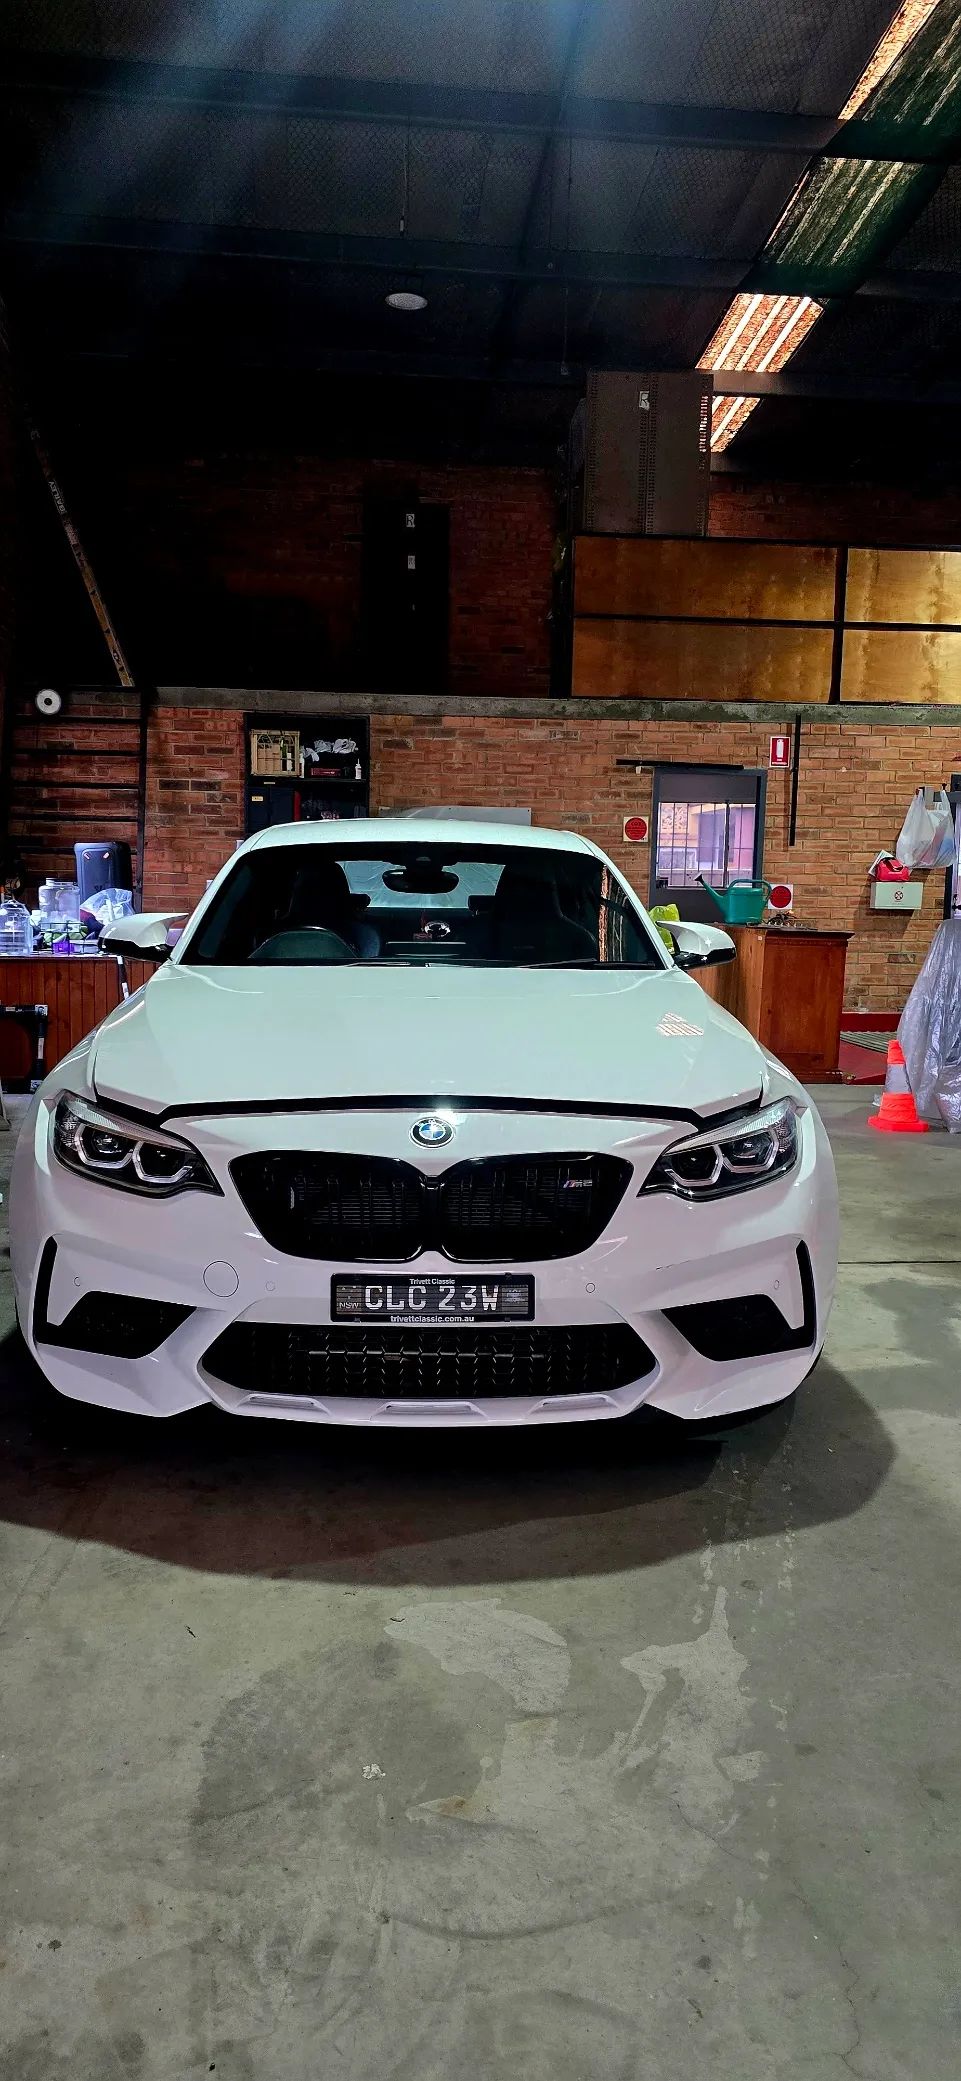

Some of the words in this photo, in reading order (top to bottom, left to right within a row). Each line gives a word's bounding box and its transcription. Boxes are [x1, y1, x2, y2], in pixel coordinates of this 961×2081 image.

[48, 481, 66, 512] BAILEY
[365, 1285, 427, 1310] CLC
[438, 1285, 499, 1310] 23W
[390, 1315, 475, 1323] trivettclassic.com.au
